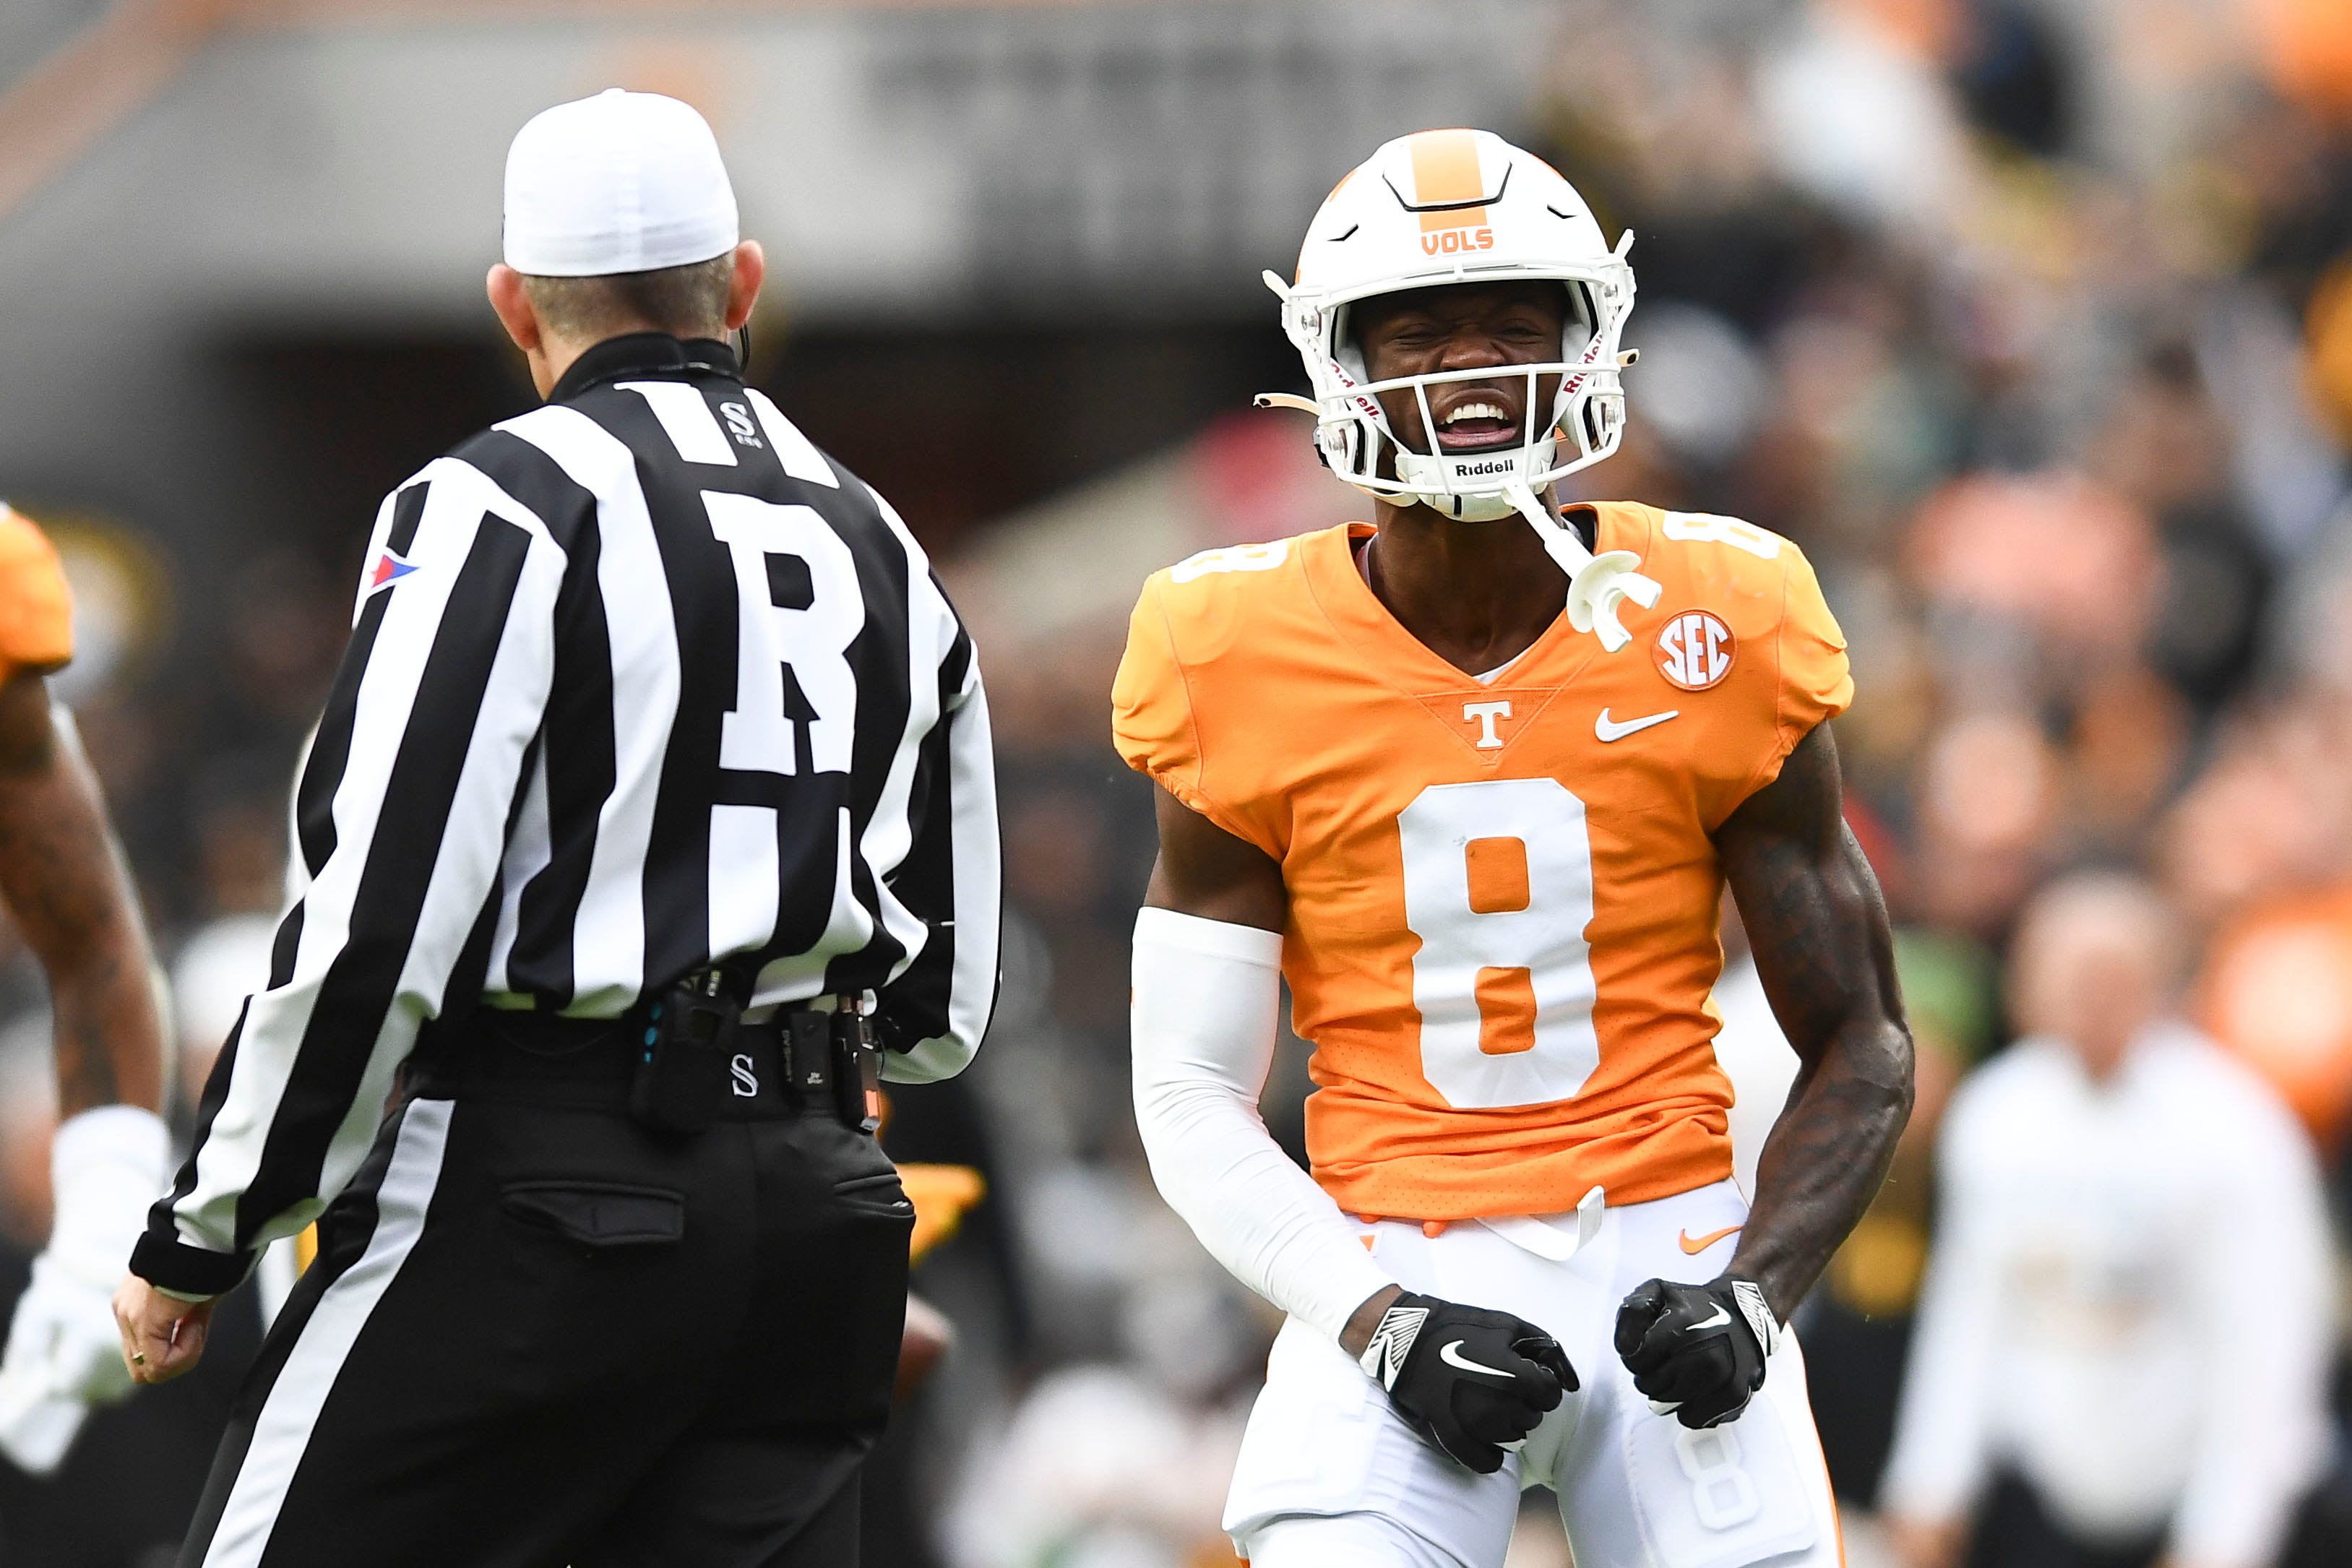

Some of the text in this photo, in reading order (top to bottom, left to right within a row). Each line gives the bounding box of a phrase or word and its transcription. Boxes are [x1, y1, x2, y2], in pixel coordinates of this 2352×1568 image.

[1421, 228, 1494, 256] VOLS
[1455, 459, 1514, 477] Riddell
[1662, 511, 1780, 559] 8
[1171, 541, 1288, 584] 8
[700, 489, 865, 776] R
[1658, 614, 1730, 685] SEC
[1463, 700, 1511, 748] T
[1397, 777, 1599, 1109] 8
[1676, 1422, 1761, 1531] 8
